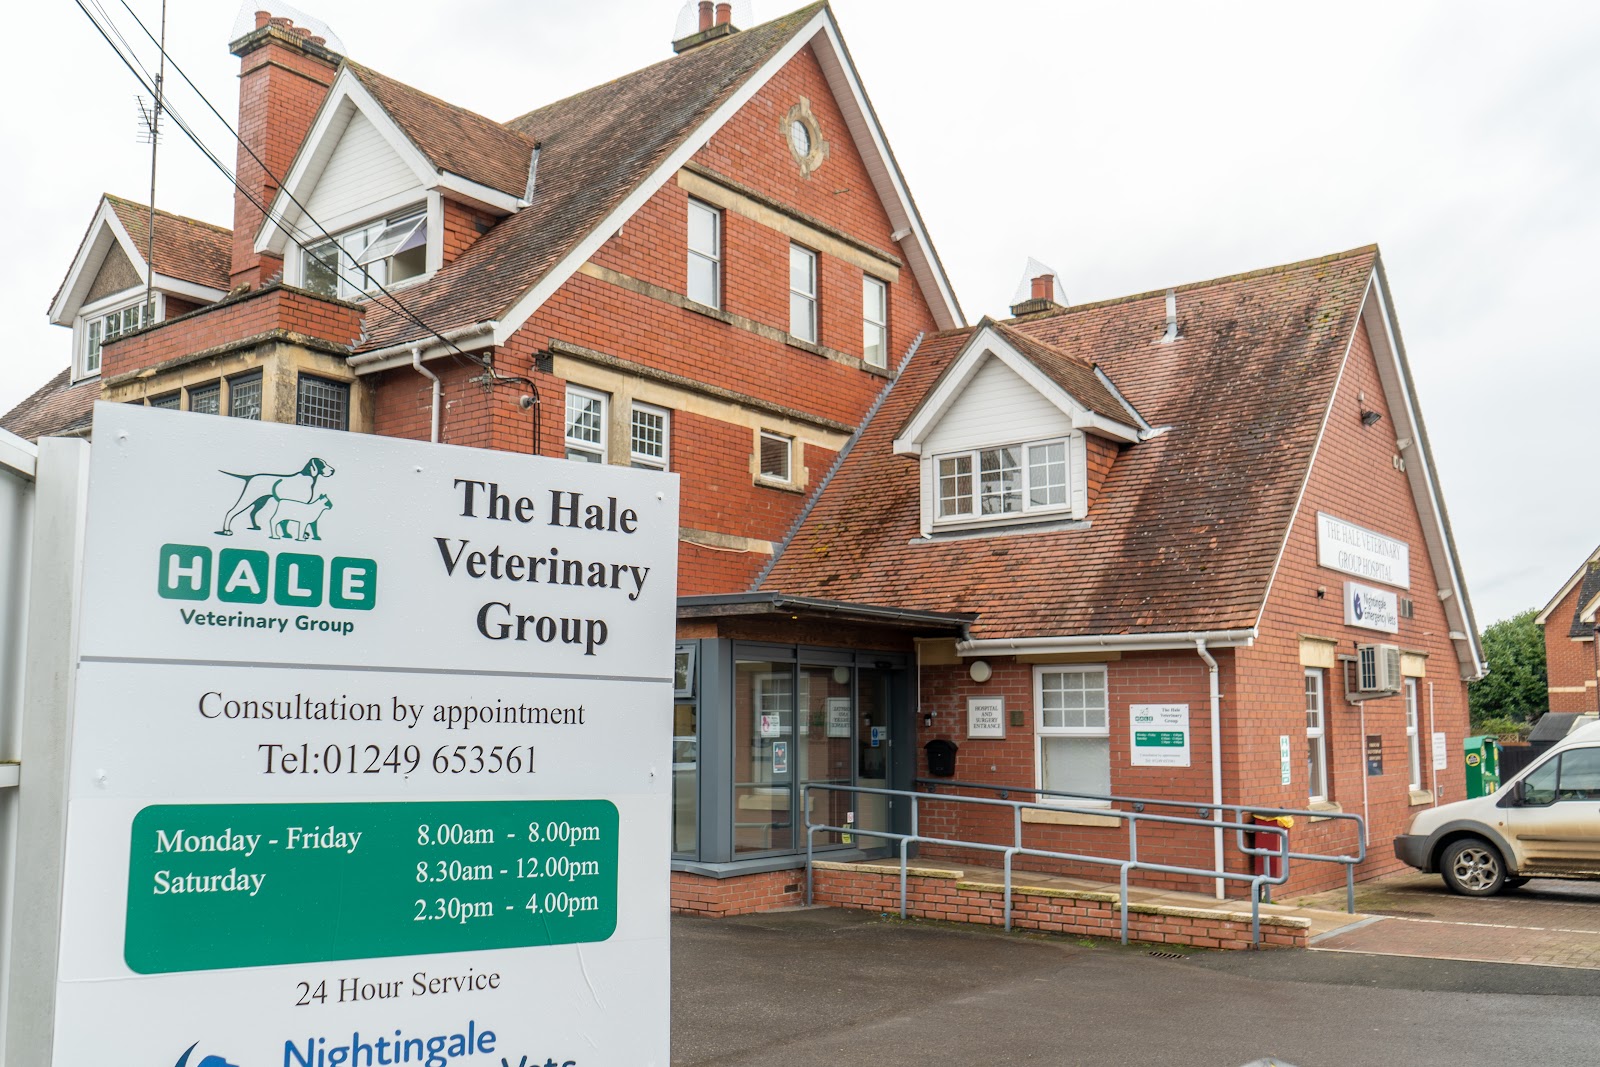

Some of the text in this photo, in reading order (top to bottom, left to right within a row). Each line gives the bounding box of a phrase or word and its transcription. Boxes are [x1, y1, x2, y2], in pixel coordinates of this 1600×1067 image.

[454, 479, 637, 534] The Hale
[1326, 520, 1401, 561] THE HALE VETERINARY
[169, 553, 366, 601] HALE
[434, 536, 650, 602] Veterinary
[1338, 550, 1393, 582] GROUP HOSPITAL
[181, 609, 354, 637] Veterinary Group
[477, 602, 607, 656] Group
[199, 692, 585, 730] Consultation by appointment
[259, 744, 534, 774] Tel:01249 653561
[155, 828, 262, 857] Monday
[286, 826, 363, 854] Friday
[417, 823, 495, 846] 8.00am
[529, 821, 601, 847] 8.00pm
[154, 868, 267, 897] Saturday
[415, 860, 494, 883] 8.30am
[517, 857, 600, 882] 12.00pm
[414, 898, 494, 925] 2.30pm
[526, 893, 599, 918] 4.00pm
[296, 968, 501, 1006] 24 Hour Service
[284, 1020, 496, 1067] Nightingale
